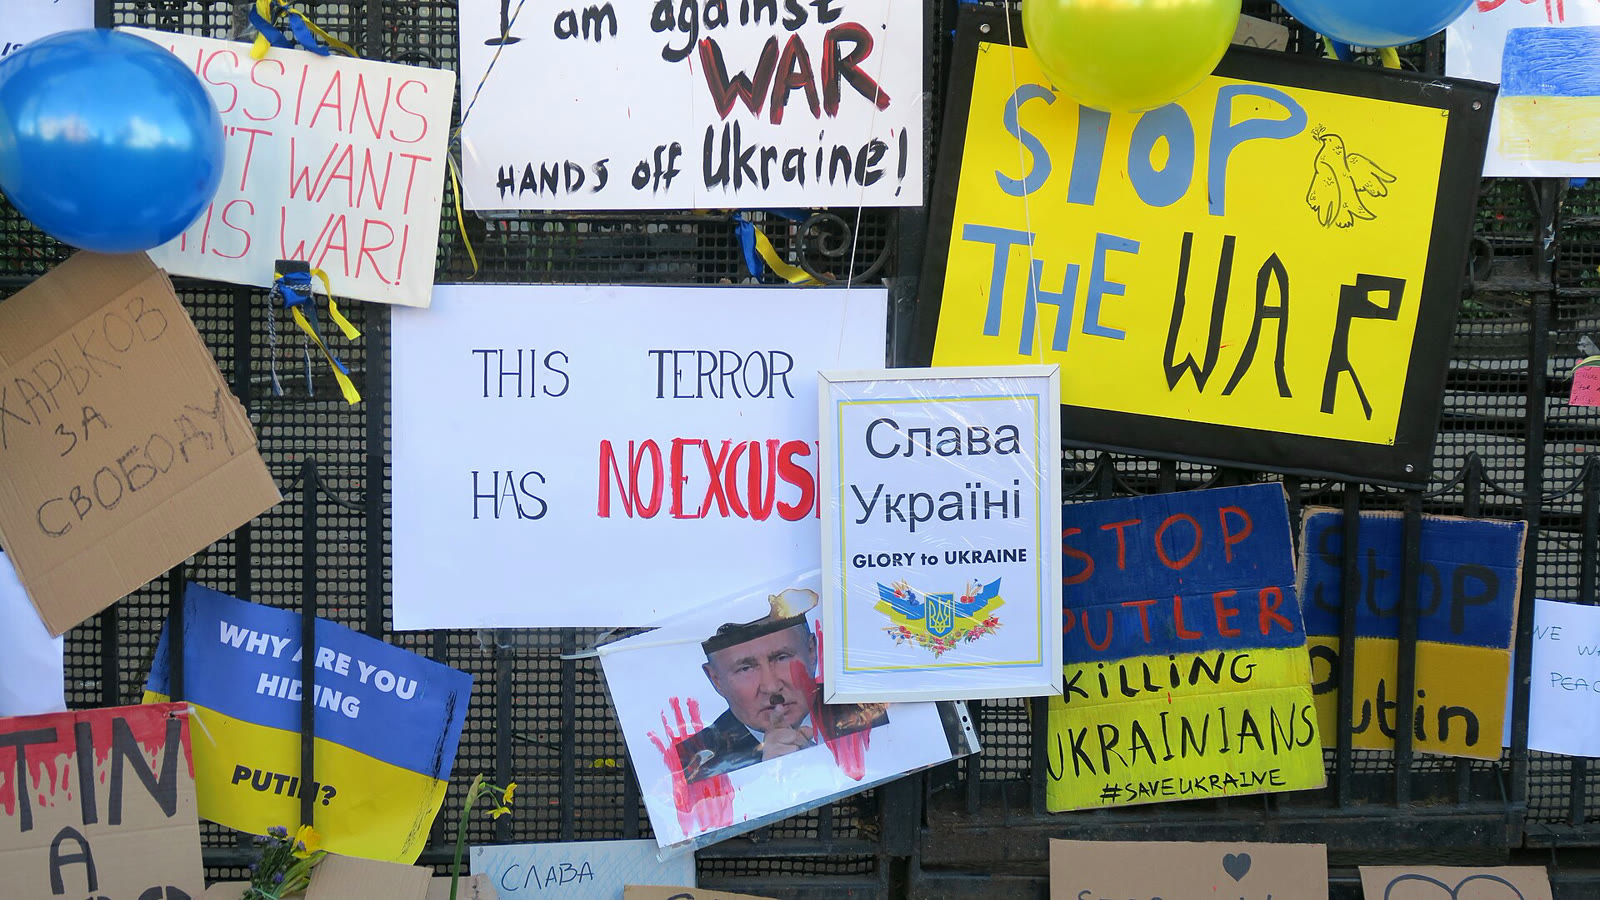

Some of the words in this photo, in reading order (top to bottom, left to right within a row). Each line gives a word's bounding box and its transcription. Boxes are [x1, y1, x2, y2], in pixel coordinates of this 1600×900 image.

[554, 3, 618, 43] am
[650, 0, 845, 63] against
[171, 45, 428, 143] SSIANS
[698, 22, 891, 125] WAR
[290, 137, 432, 215] WANT
[496, 158, 610, 199] HANDS
[632, 142, 682, 195] off
[702, 119, 908, 197] Ukraine!
[281, 206, 411, 286] WAR!
[962, 224, 1140, 357] THE
[1163, 232, 1406, 421] WAR
[472, 348, 571, 398] THIS
[648, 350, 795, 399] TERROR
[36, 387, 235, 538] СВОБОДУ
[55, 406, 112, 457] ЗА
[864, 418, 1021, 459] Слава
[470, 471, 549, 520] HAS
[669, 437, 822, 522] EXCUS
[850, 479, 1021, 533] Україні
[852, 552, 916, 569] GLORY
[920, 552, 939, 567] to
[945, 548, 1028, 566] UKRAINE
[1062, 505, 1254, 585] STOP
[219, 620, 292, 658] WHY
[357, 660, 418, 700] YOU
[1047, 702, 1316, 782] UKRAINIANS
[1100, 768, 1287, 804] #SAVEUKRAINE
[49, 825, 99, 895] A
[501, 861, 594, 891] СЛАВА
